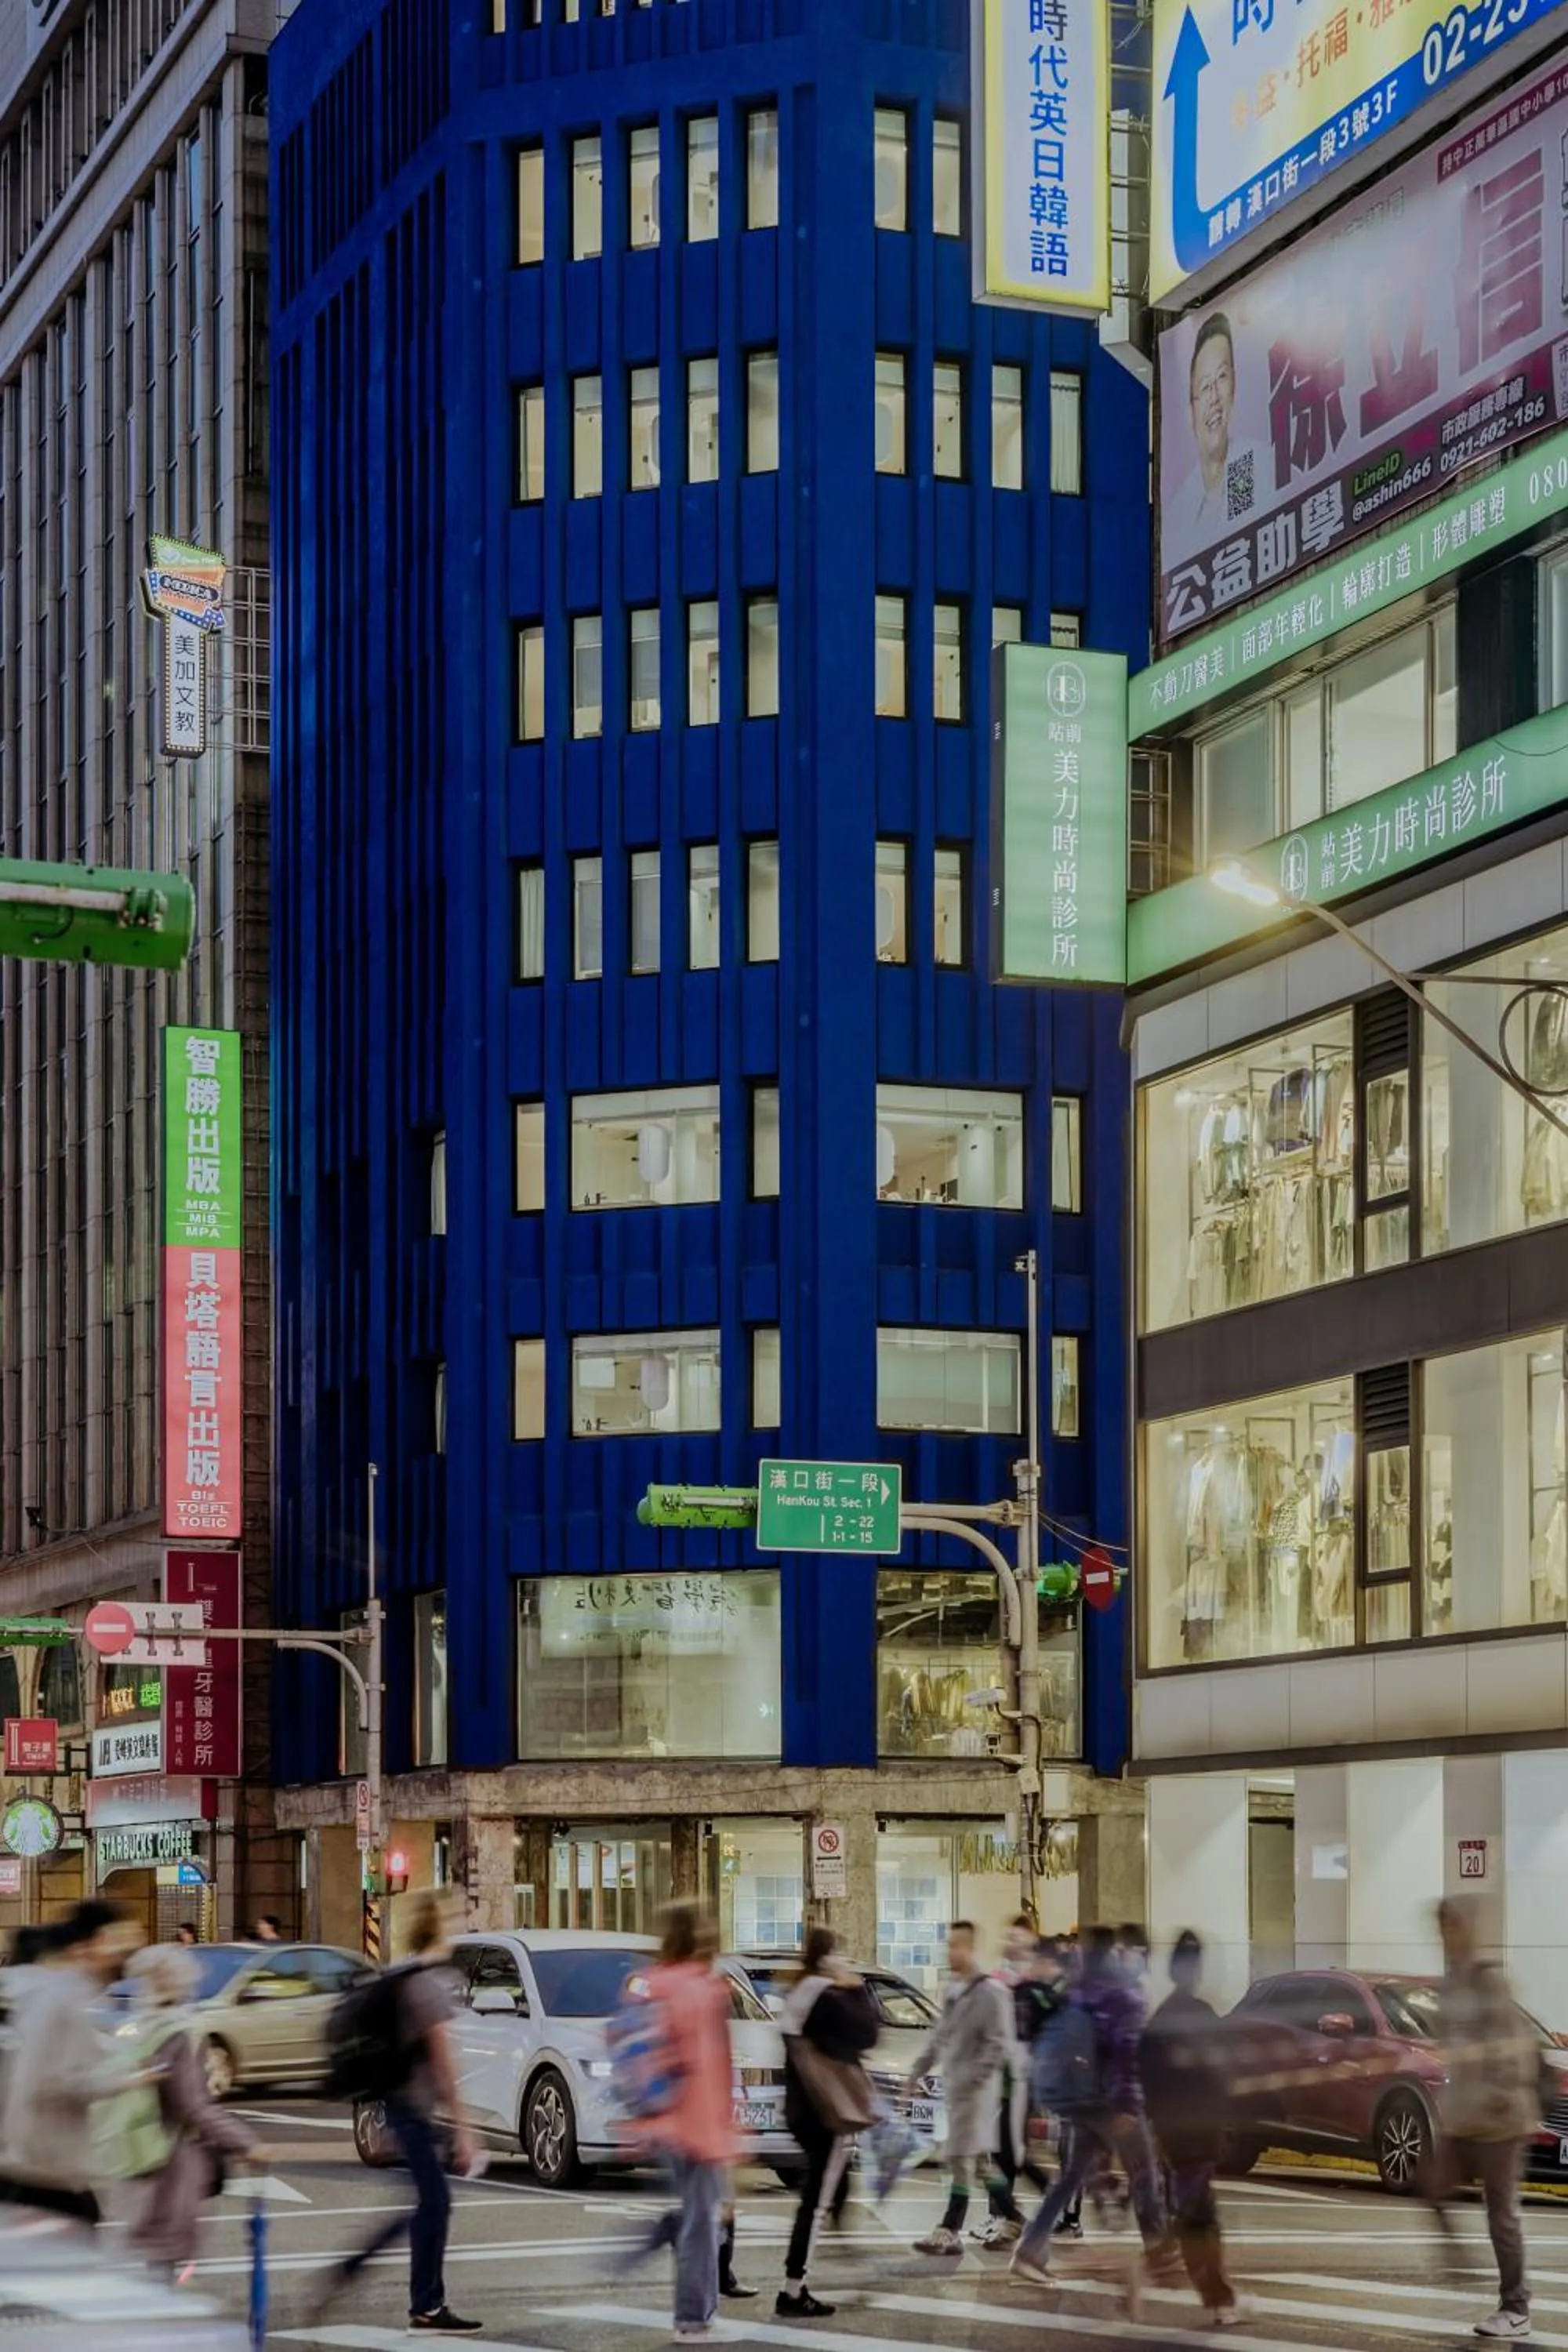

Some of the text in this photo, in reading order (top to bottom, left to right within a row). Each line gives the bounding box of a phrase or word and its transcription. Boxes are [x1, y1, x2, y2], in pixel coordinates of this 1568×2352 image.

[1352, 456, 1432, 521] @ashin666
[1166, 480, 1345, 631] 公益助學
[175, 635, 195, 732] 美加文教
[1340, 755, 1507, 884] 美力時尚診所
[1051, 750, 1079, 967] 美力時尚診所
[186, 1200, 220, 1210] MBA
[186, 1227, 220, 1238] MPA
[184, 1253, 222, 1487] 貝塔語言出版
[770, 1468, 878, 1493] 漢口街一段
[177, 1503, 229, 1515] TOEFL
[777, 1495, 819, 1507] HanKou
[866, 1497, 872, 1508] 1
[179, 1516, 227, 1528] TOEIC
[834, 1515, 844, 1526] 2
[100, 1829, 192, 1861] STARBUCKS COFFEE
[1466, 1856, 1479, 1872] 20
